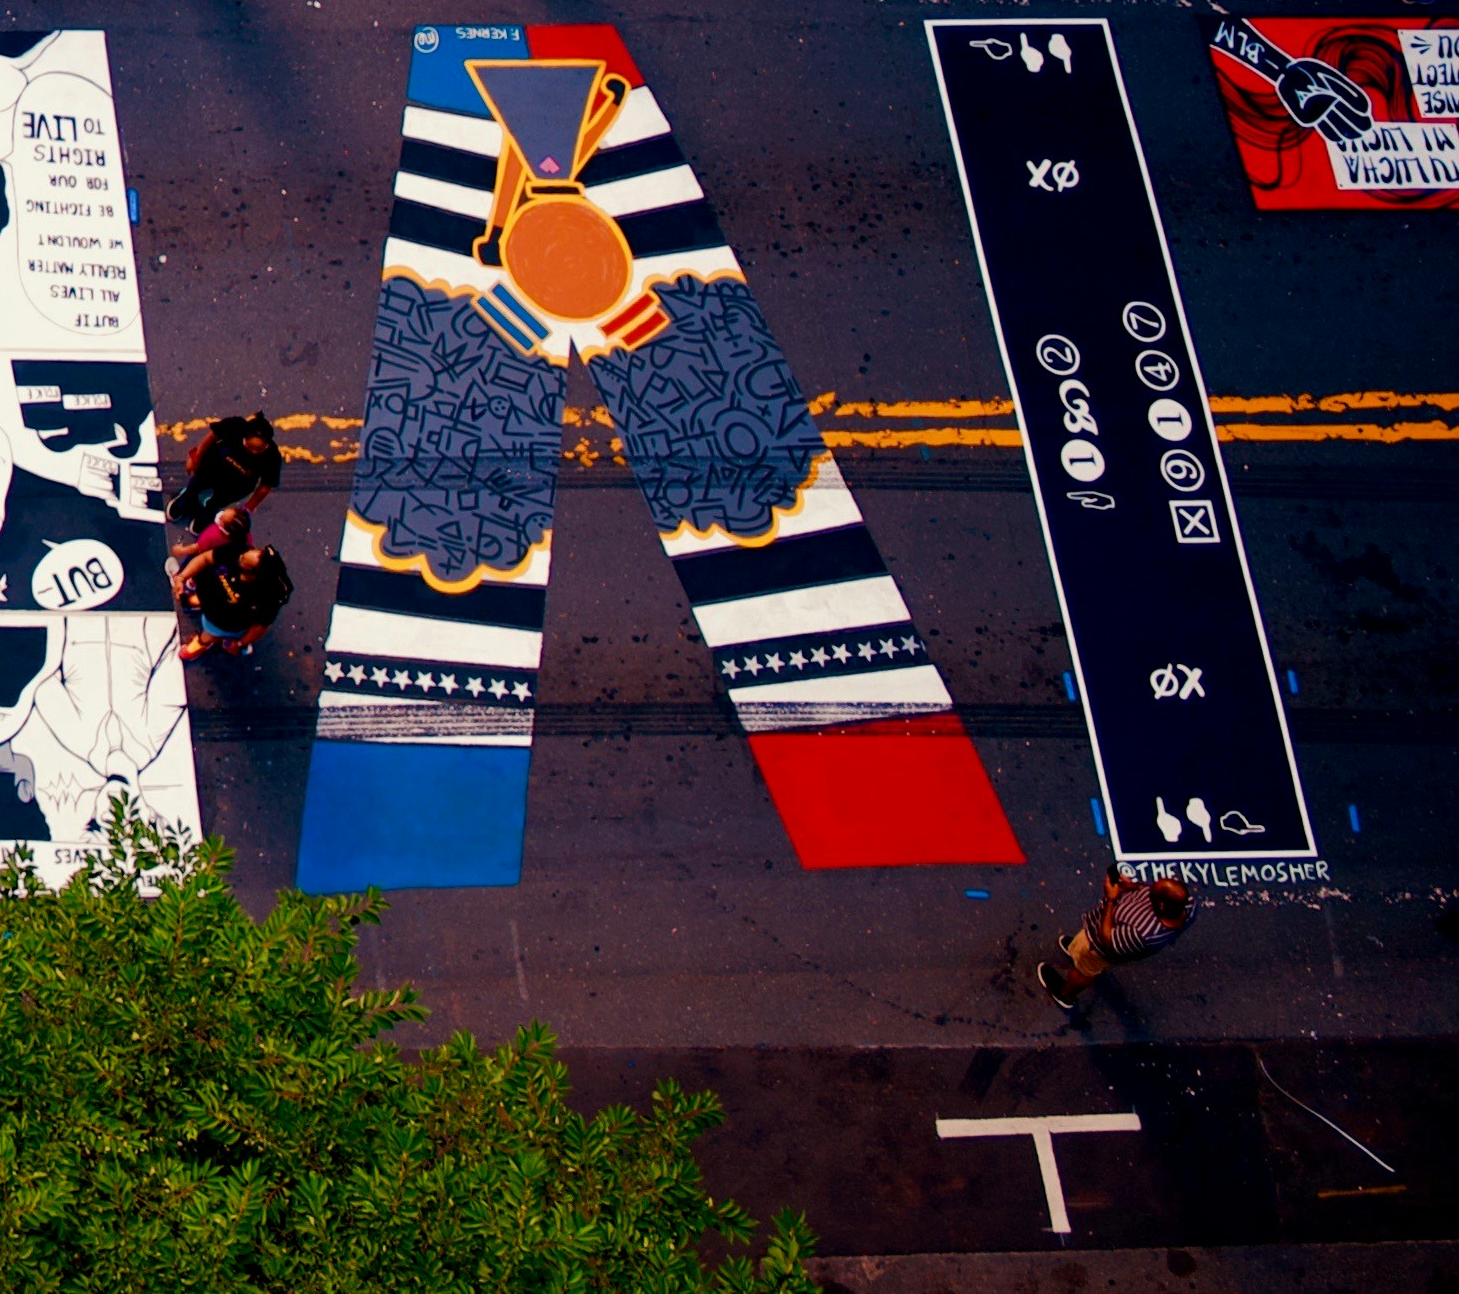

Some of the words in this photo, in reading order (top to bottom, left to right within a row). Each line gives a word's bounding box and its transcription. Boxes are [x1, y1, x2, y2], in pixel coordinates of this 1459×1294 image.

[455, 27, 507, 40] KERNES
[1214, 21, 1265, 65] BLM
[22, 112, 77, 142] LIVE
[84, 118, 104, 135] TO
[1423, 128, 1456, 151] MI
[33, 145, 106, 166] RIGHTS
[1344, 156, 1429, 184] LUCHA
[49, 175, 77, 188] OUR
[86, 177, 109, 190] FOR
[26, 200, 91, 216] FIGHTING
[99, 206, 114, 217] BE
[108, 239, 124, 249] WE
[28, 260, 74, 274] MATTER
[79, 263, 126, 280] REALLY
[50, 285, 94, 300] LIVES
[100, 289, 120, 302] ALL
[74, 314, 89, 327] IF
[94, 315, 119, 328] BUT
[1117, 861, 1331, 886] @THEKYLEMOSHER
